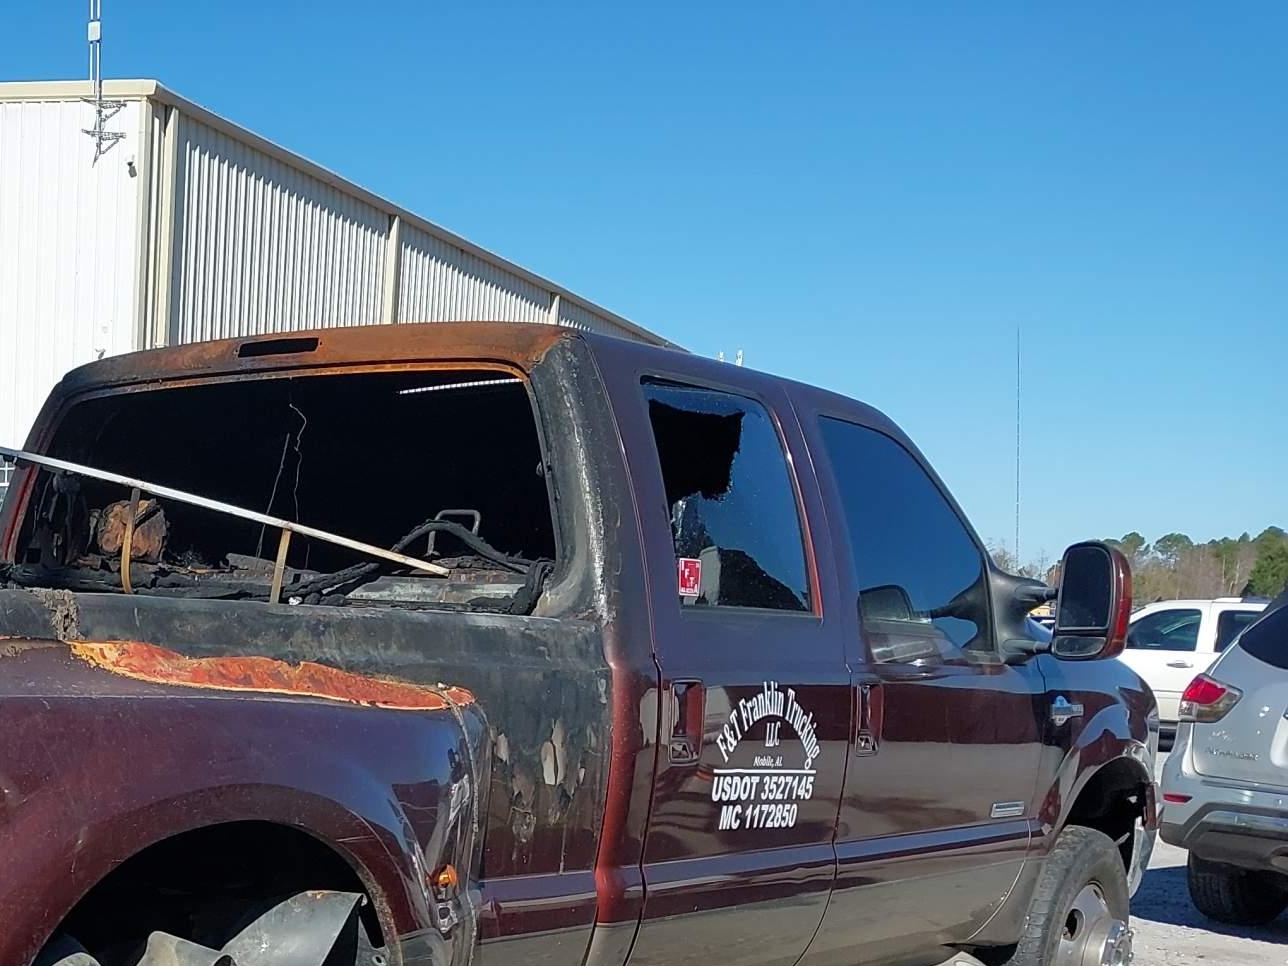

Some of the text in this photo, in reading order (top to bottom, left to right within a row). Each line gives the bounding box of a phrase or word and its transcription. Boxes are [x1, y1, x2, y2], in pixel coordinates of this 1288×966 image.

[715, 681, 821, 769] F&T Franklin Trucking
[765, 721, 781, 747] LLC
[712, 776, 813, 802] USDOT 3527145
[719, 803, 798, 830] MC 1172850
